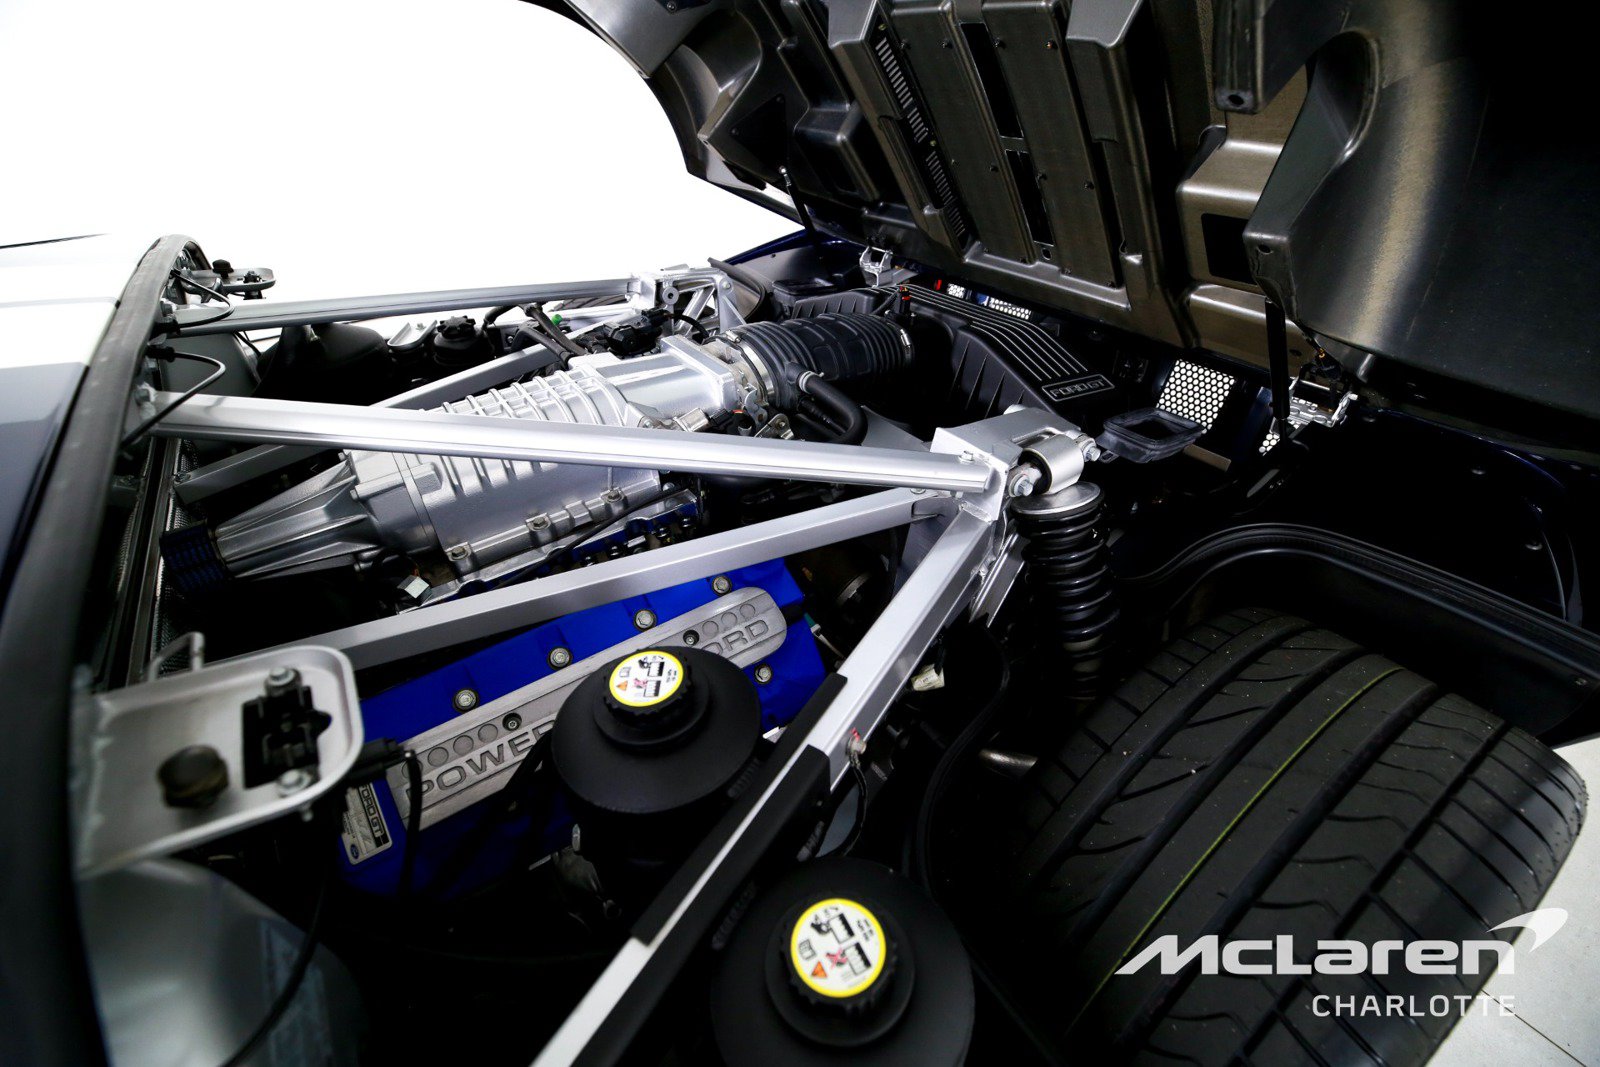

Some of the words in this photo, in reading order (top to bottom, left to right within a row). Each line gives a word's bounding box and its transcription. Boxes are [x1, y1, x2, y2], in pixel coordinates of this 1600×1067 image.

[1050, 383, 1089, 397] FORD
[1086, 379, 1105, 390] GT
[405, 719, 556, 799] POWE
[701, 619, 769, 656] ORD
[370, 816, 384, 835] GT
